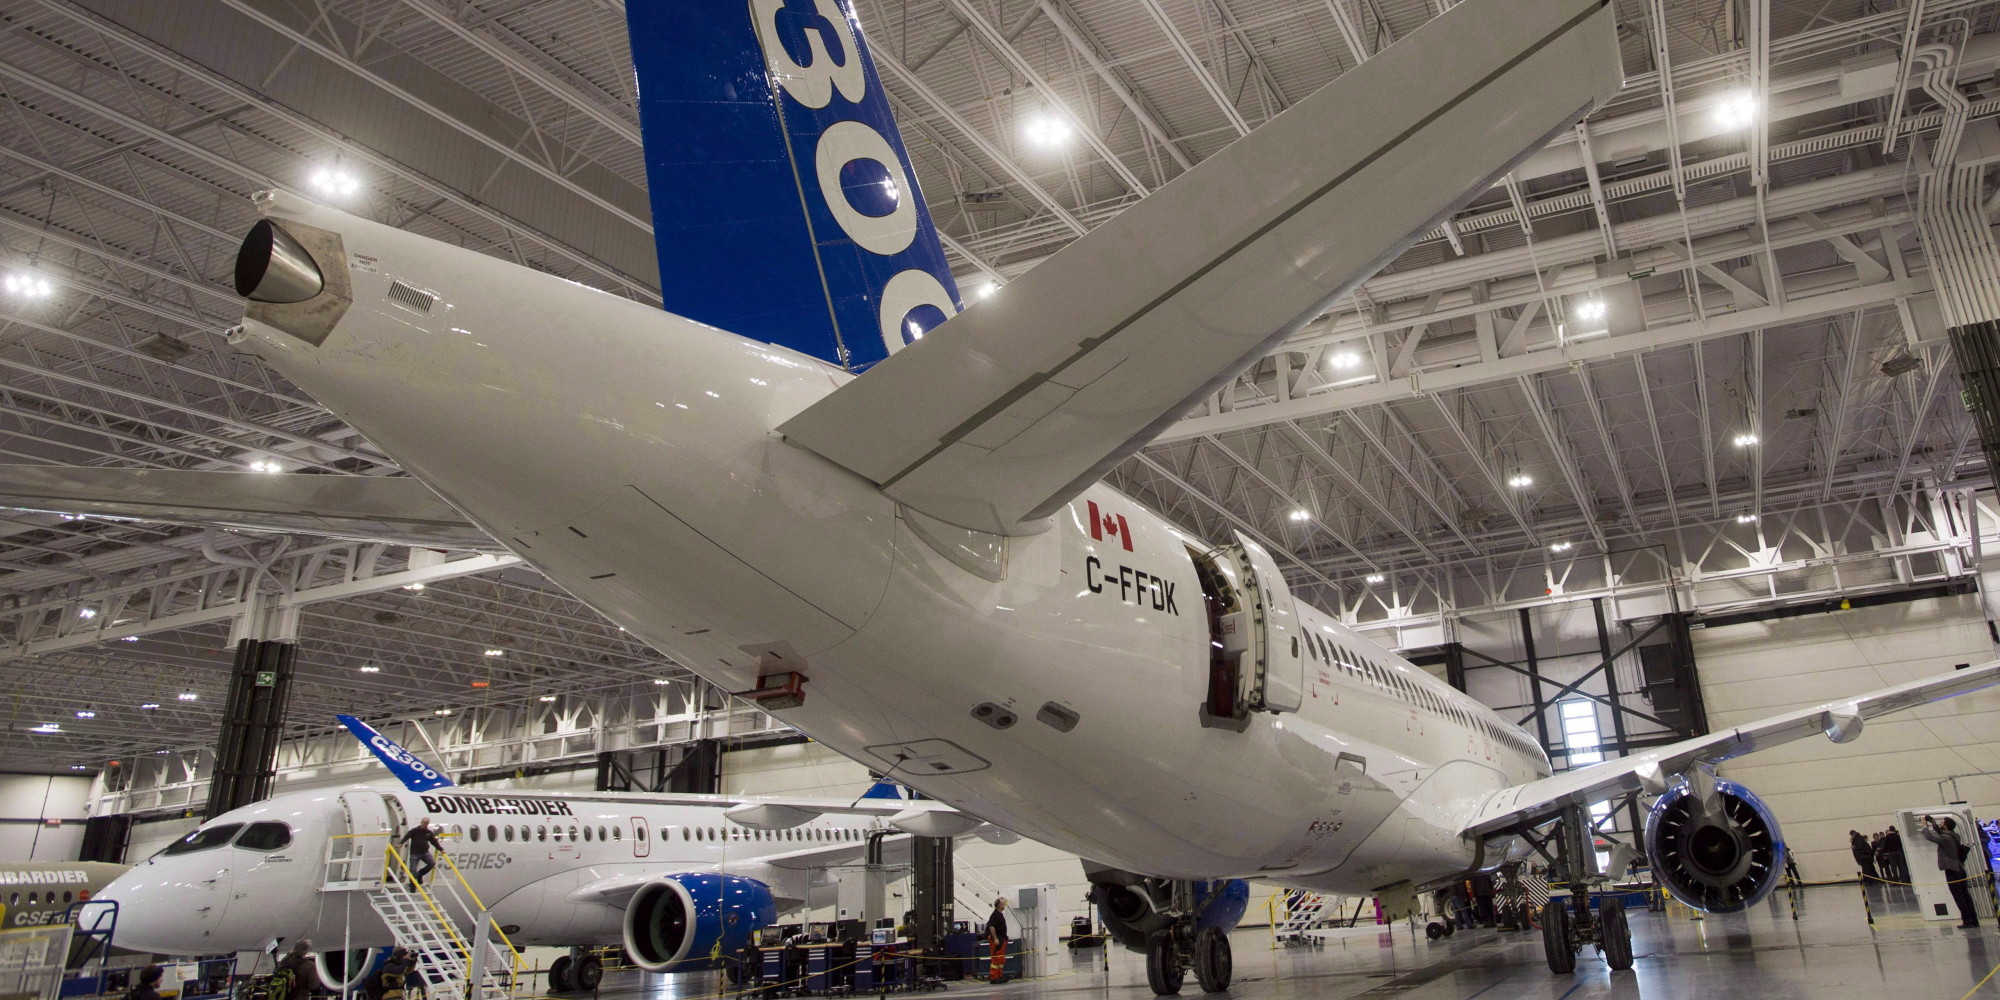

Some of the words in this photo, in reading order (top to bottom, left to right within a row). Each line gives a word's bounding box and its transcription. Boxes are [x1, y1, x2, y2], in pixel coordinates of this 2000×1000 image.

[354, 253, 378, 262] DANGER
[1086, 556, 1179, 616] C-FFDK
[371, 735, 438, 780] CS300
[420, 795, 574, 816] BOMBARDIER
[437, 852, 507, 870] SERIES
